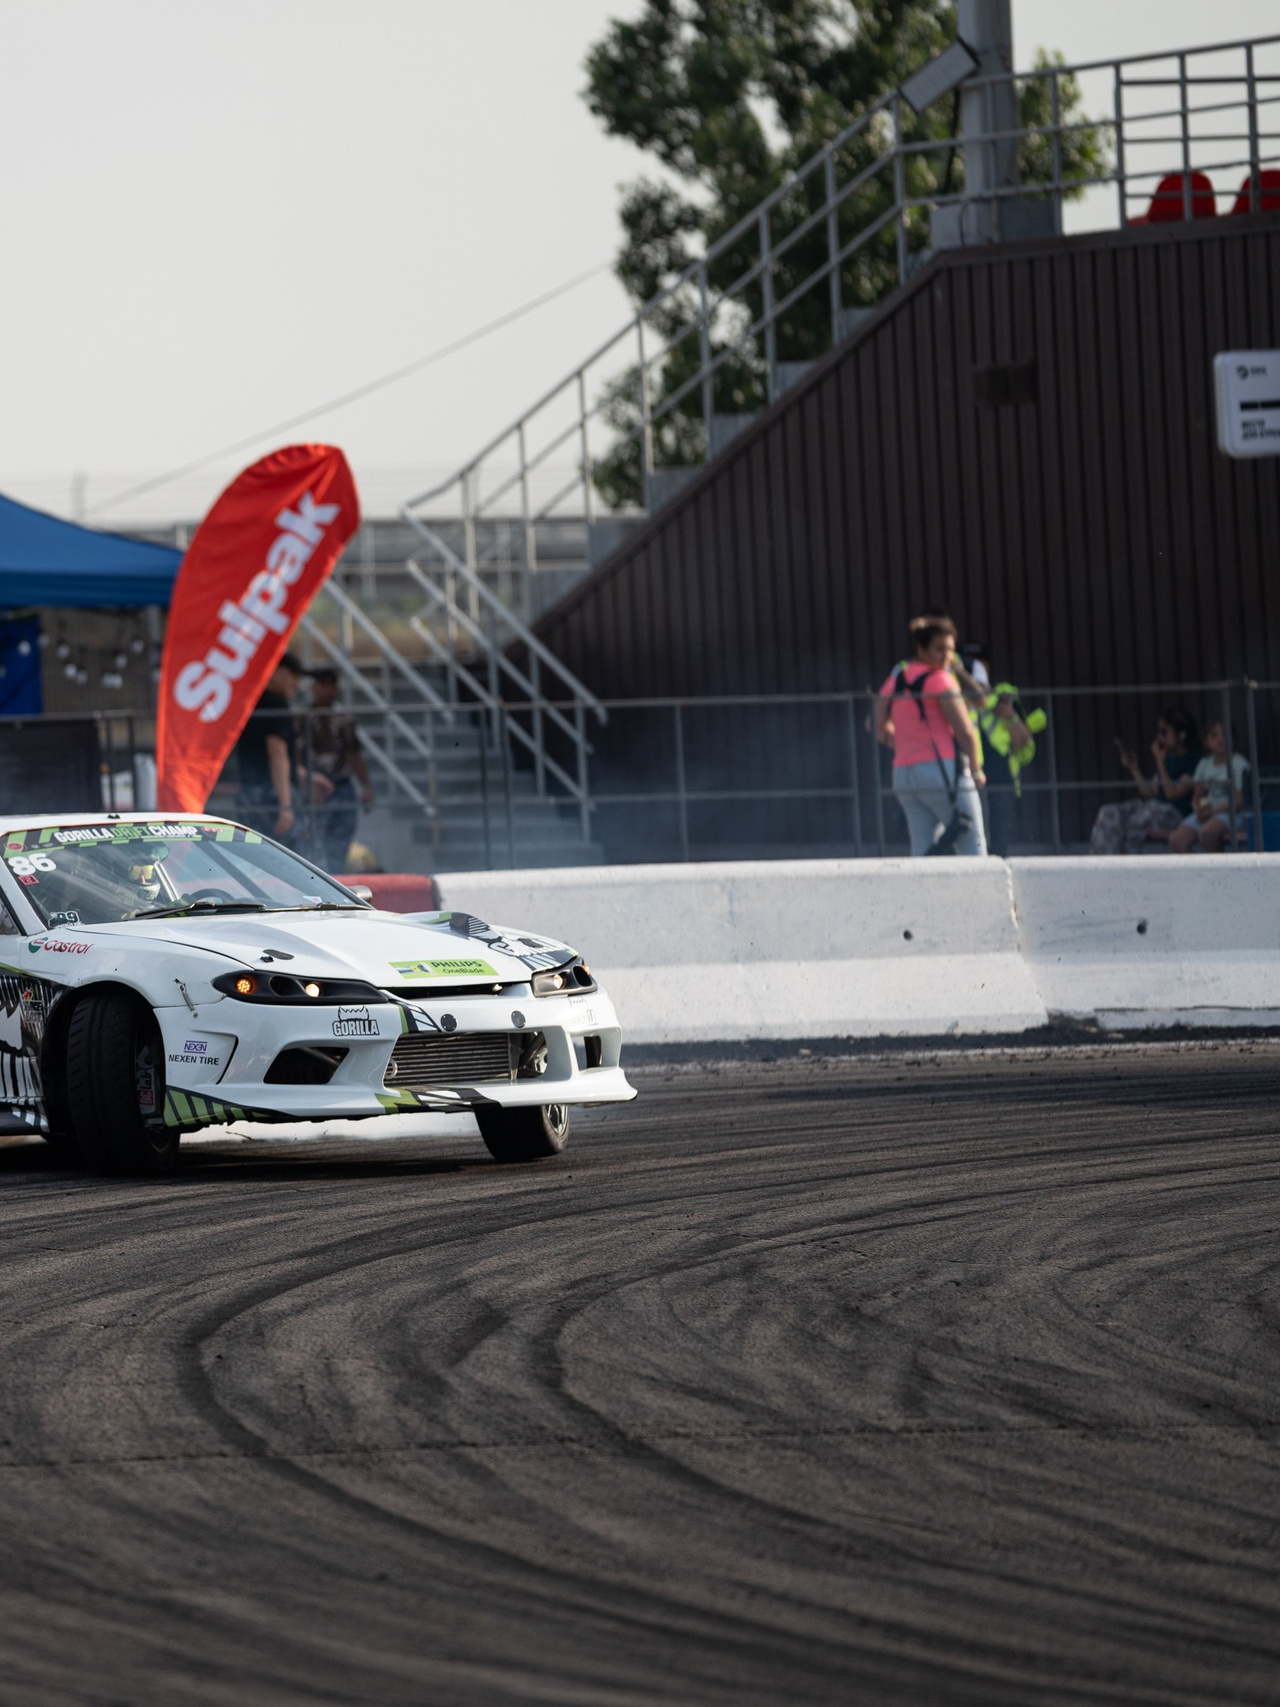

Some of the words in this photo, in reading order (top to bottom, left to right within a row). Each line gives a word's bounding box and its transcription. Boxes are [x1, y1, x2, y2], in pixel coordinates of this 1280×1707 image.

[173, 490, 342, 723] Sulpak
[53, 828, 114, 843] GORILLA
[148, 825, 198, 837] CHAMP
[8, 852, 57, 876] 86
[44, 940, 95, 955] Castrol
[332, 1020, 380, 1036] GORILLA
[184, 1043, 207, 1052] NEXEN
[169, 1054, 197, 1063] NEXEN
[199, 1056, 220, 1066] TIRE
